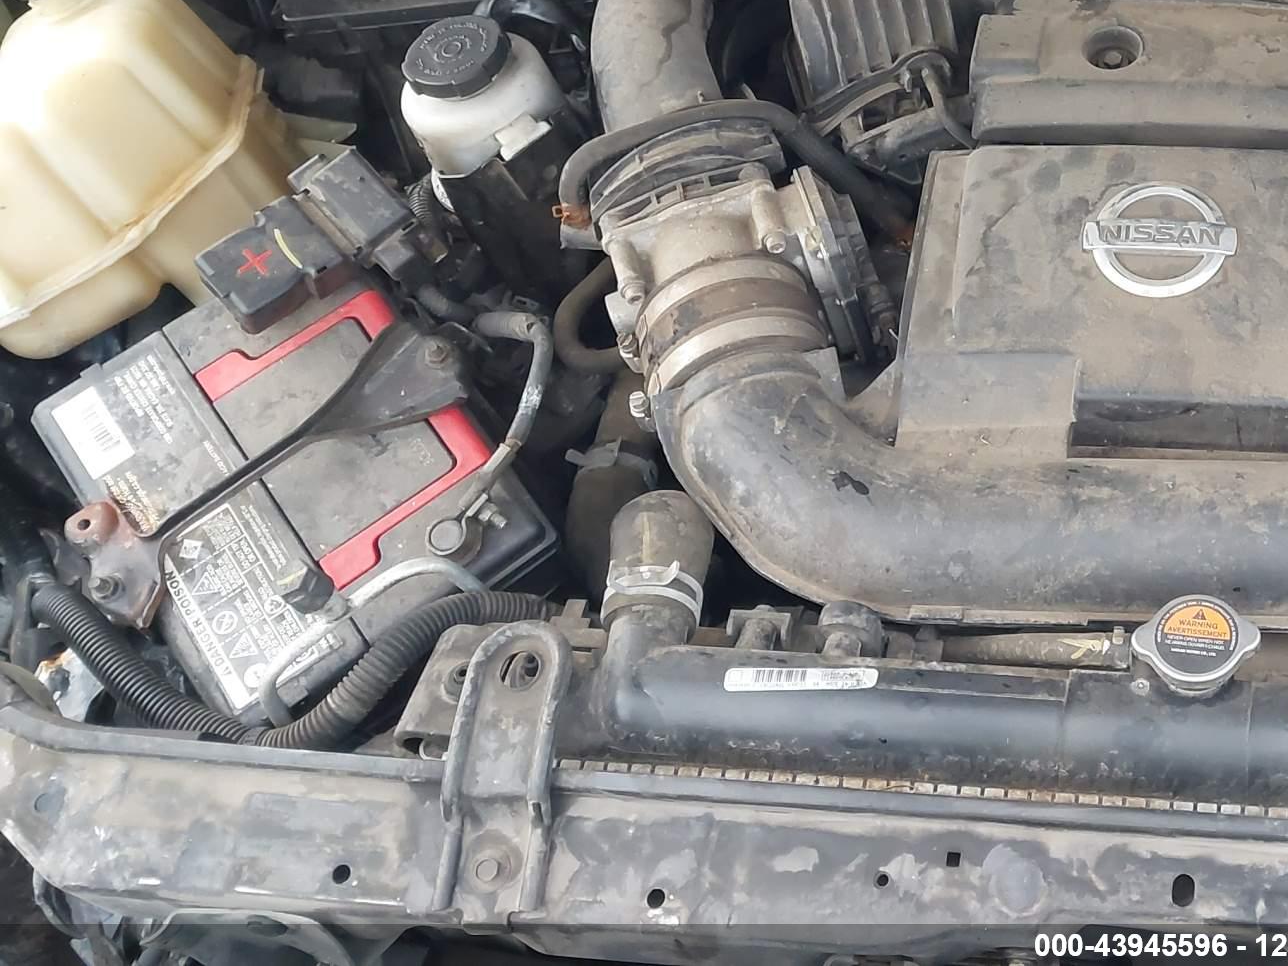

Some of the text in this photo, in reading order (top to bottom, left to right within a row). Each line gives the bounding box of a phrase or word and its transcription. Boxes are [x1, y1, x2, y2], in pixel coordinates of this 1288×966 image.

[1100, 224, 1221, 246] NISSAN
[161, 569, 226, 667] DANGER POISON
[1178, 619, 1218, 630] WARNING
[1167, 626, 1227, 638] AVERTISSEMENT
